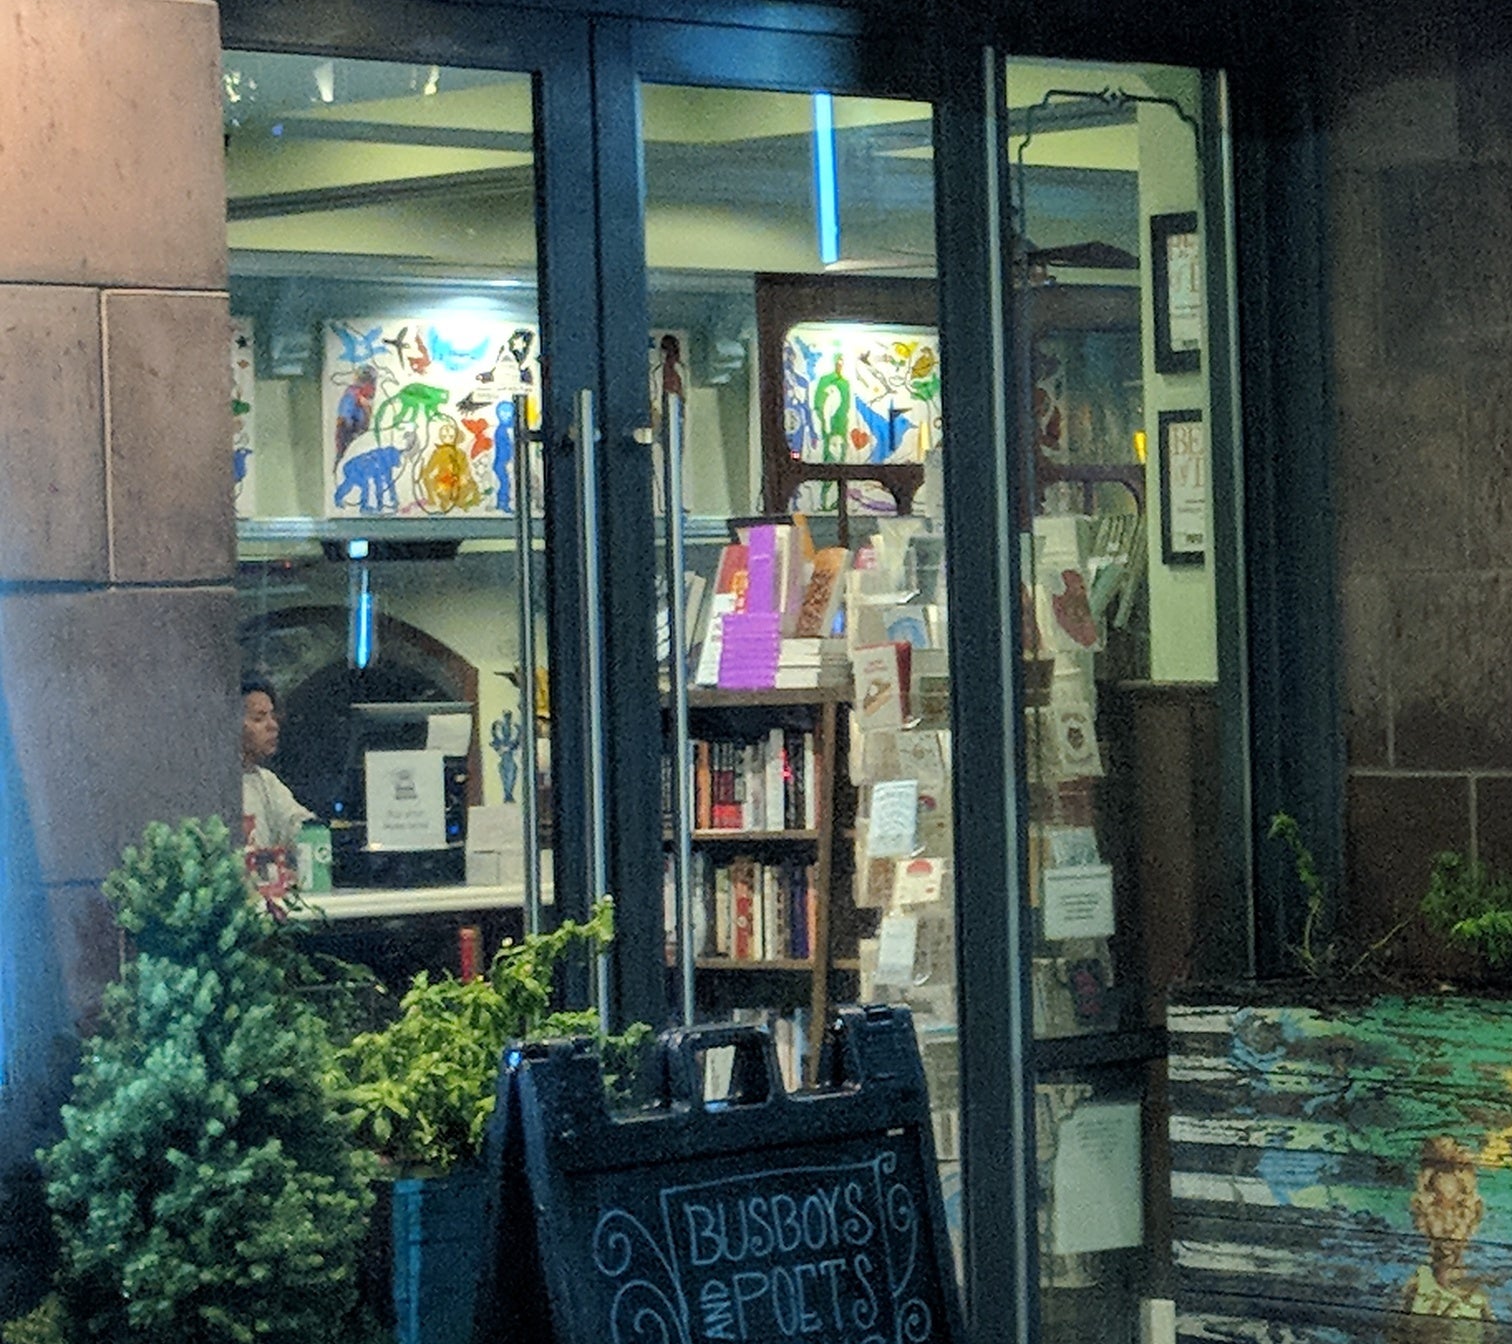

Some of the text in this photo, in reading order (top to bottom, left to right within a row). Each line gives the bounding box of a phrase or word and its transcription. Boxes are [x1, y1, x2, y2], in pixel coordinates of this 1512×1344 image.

[683, 1180, 875, 1267] BUSBOYS
[702, 1256, 879, 1341] AND POETS
